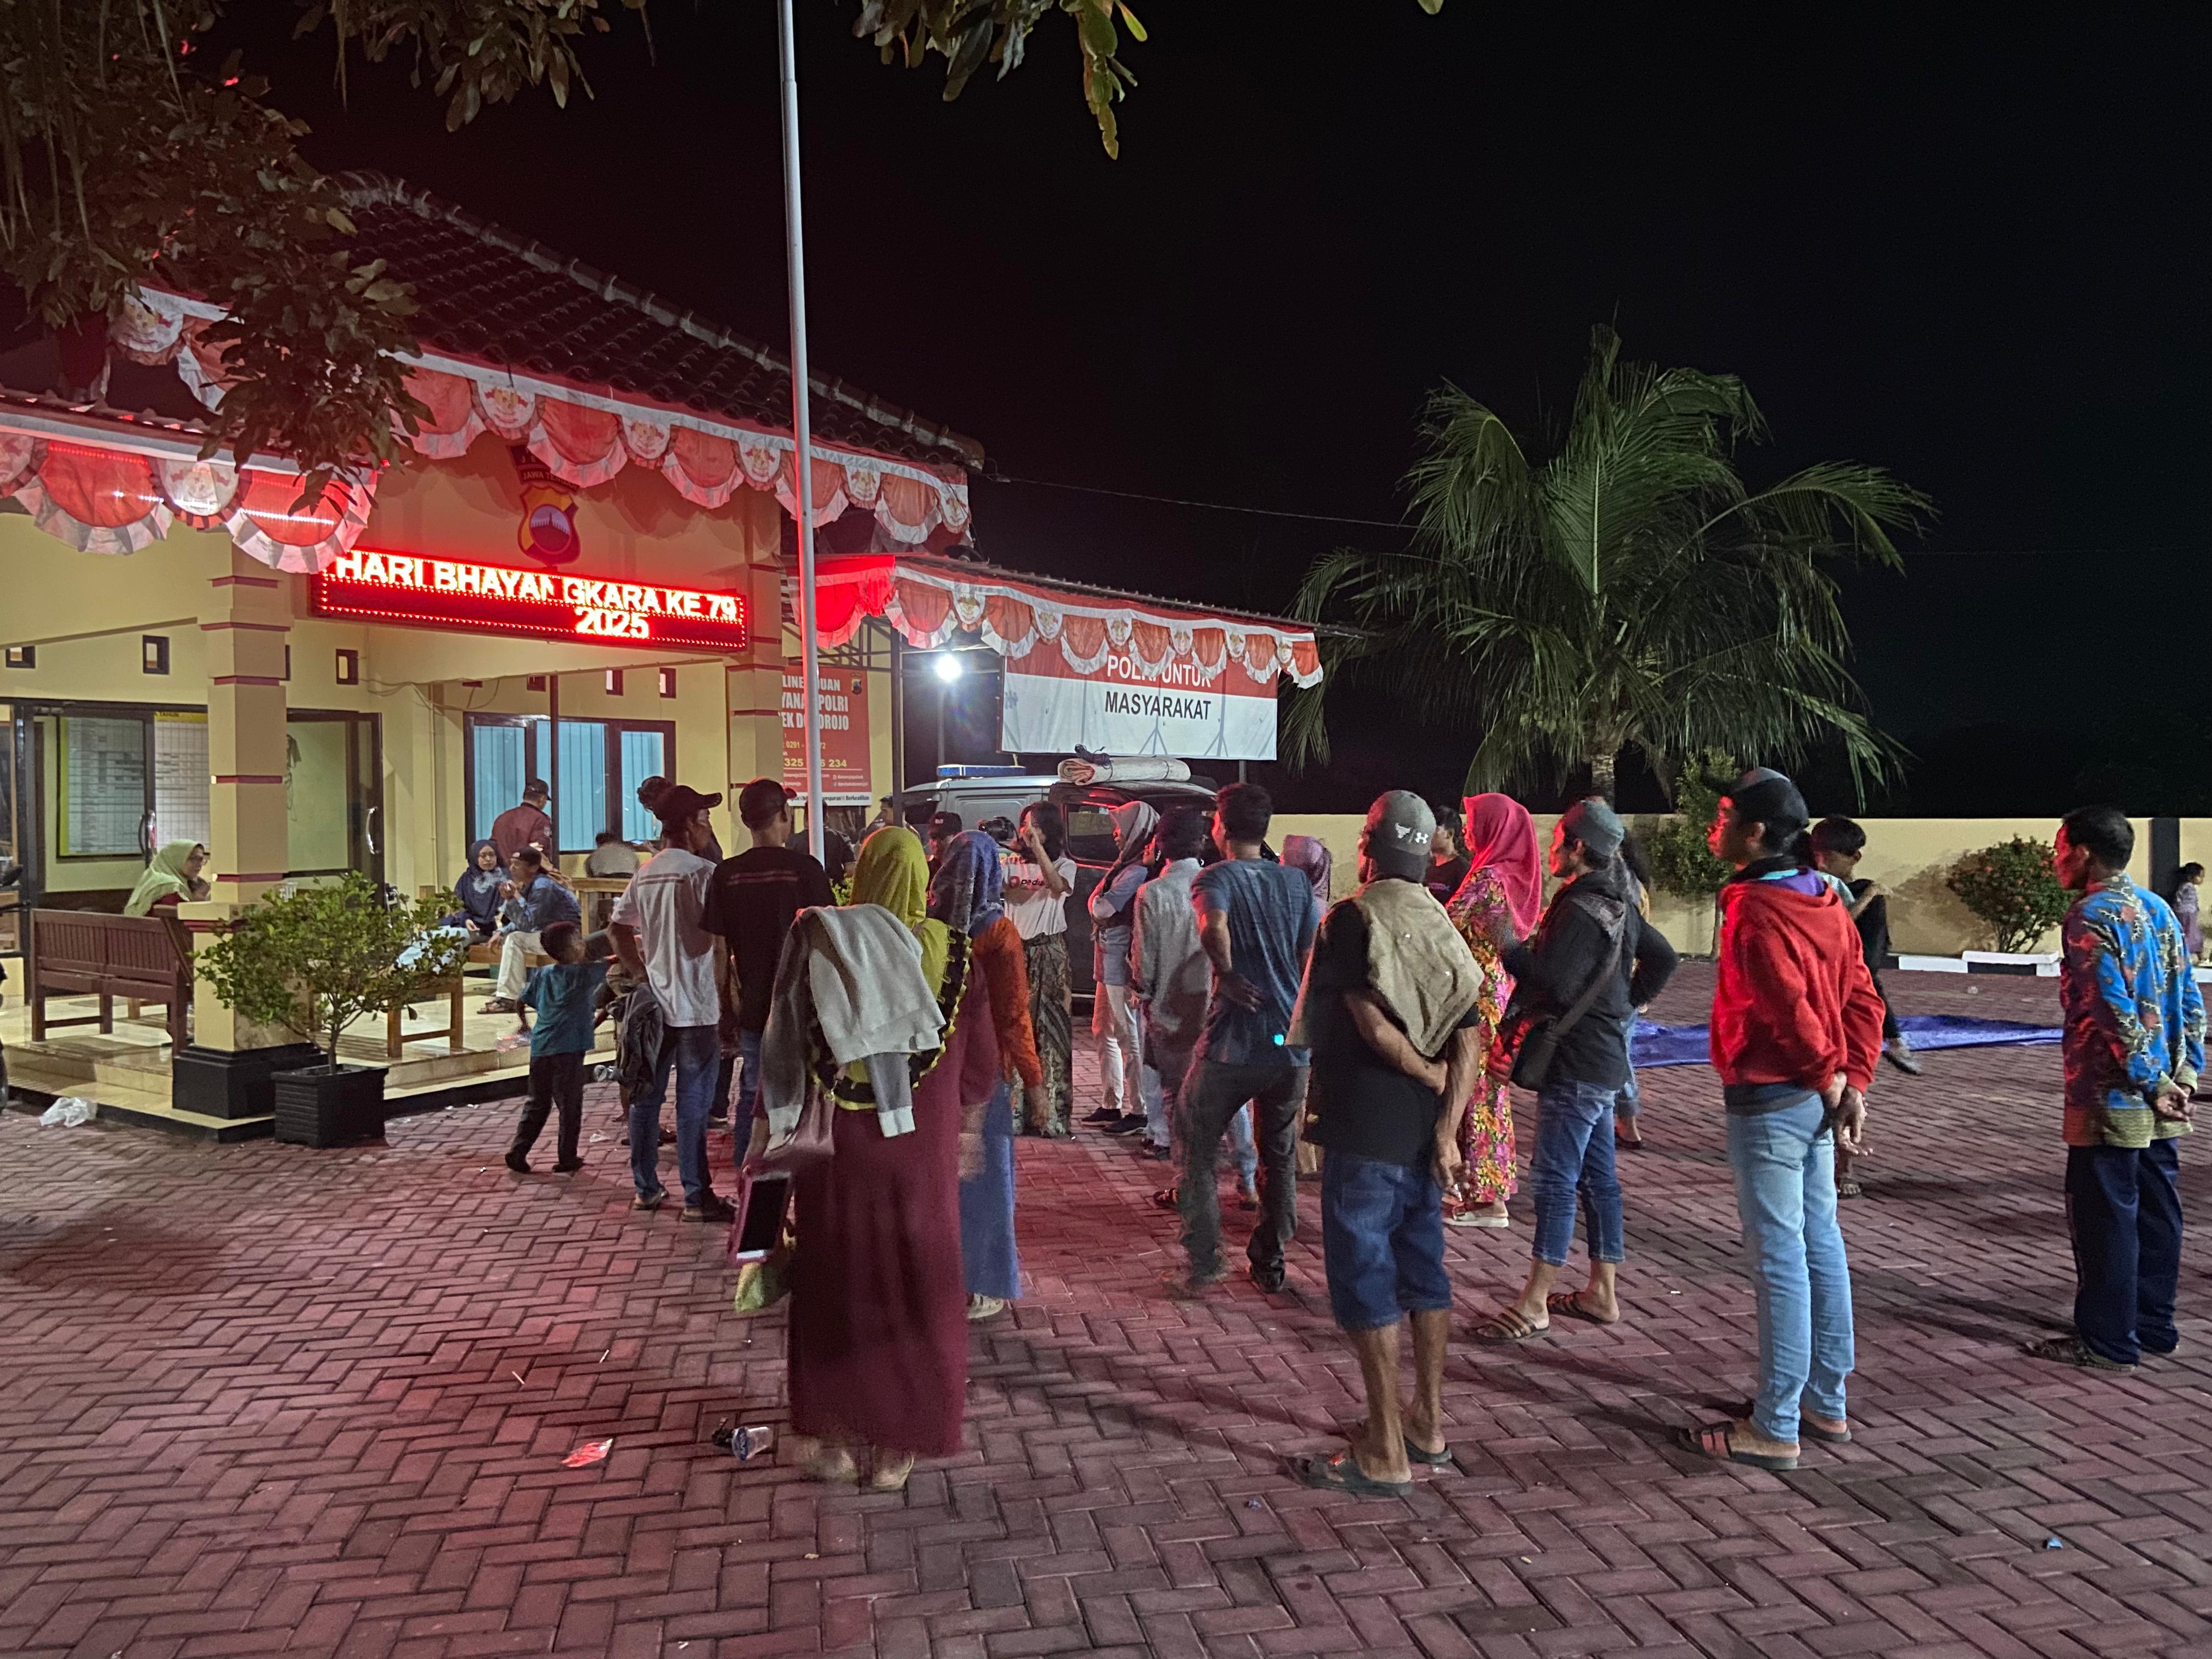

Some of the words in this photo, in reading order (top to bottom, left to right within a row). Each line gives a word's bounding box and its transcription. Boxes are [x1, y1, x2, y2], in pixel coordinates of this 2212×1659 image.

[523, 471, 544, 481] JAWA
[336, 551, 424, 588] HARI
[665, 590, 702, 617] KE
[706, 595, 737, 620] 79
[574, 606, 650, 639] 2025
[1105, 691, 1211, 720] MASYARAKAT
[784, 758, 804, 767] 325
[828, 759, 848, 768] 234
